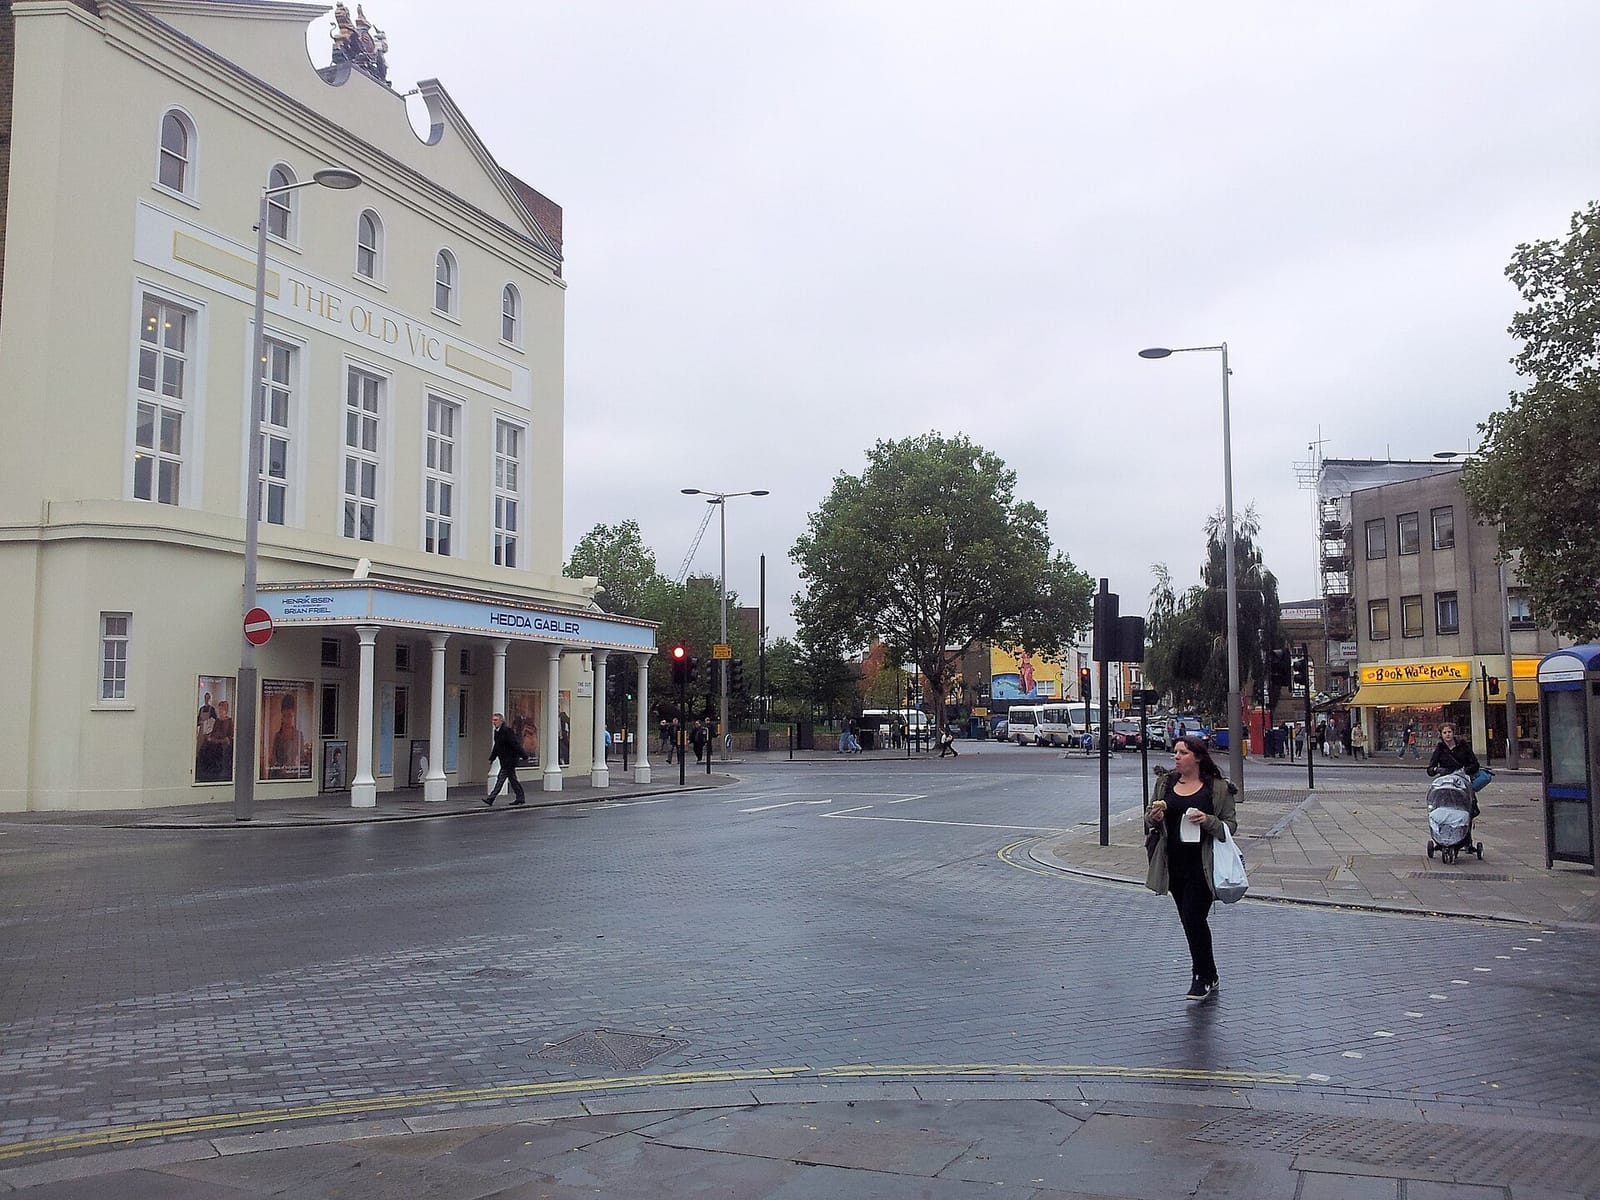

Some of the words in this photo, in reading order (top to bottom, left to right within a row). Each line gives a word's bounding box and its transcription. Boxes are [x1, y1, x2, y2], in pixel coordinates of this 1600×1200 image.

[288, 278, 342, 323] THE
[350, 305, 399, 344] OLD
[284, 607, 308, 615] BRIAN
[490, 612, 532, 629] HEDDA
[533, 618, 580, 635] GABLER
